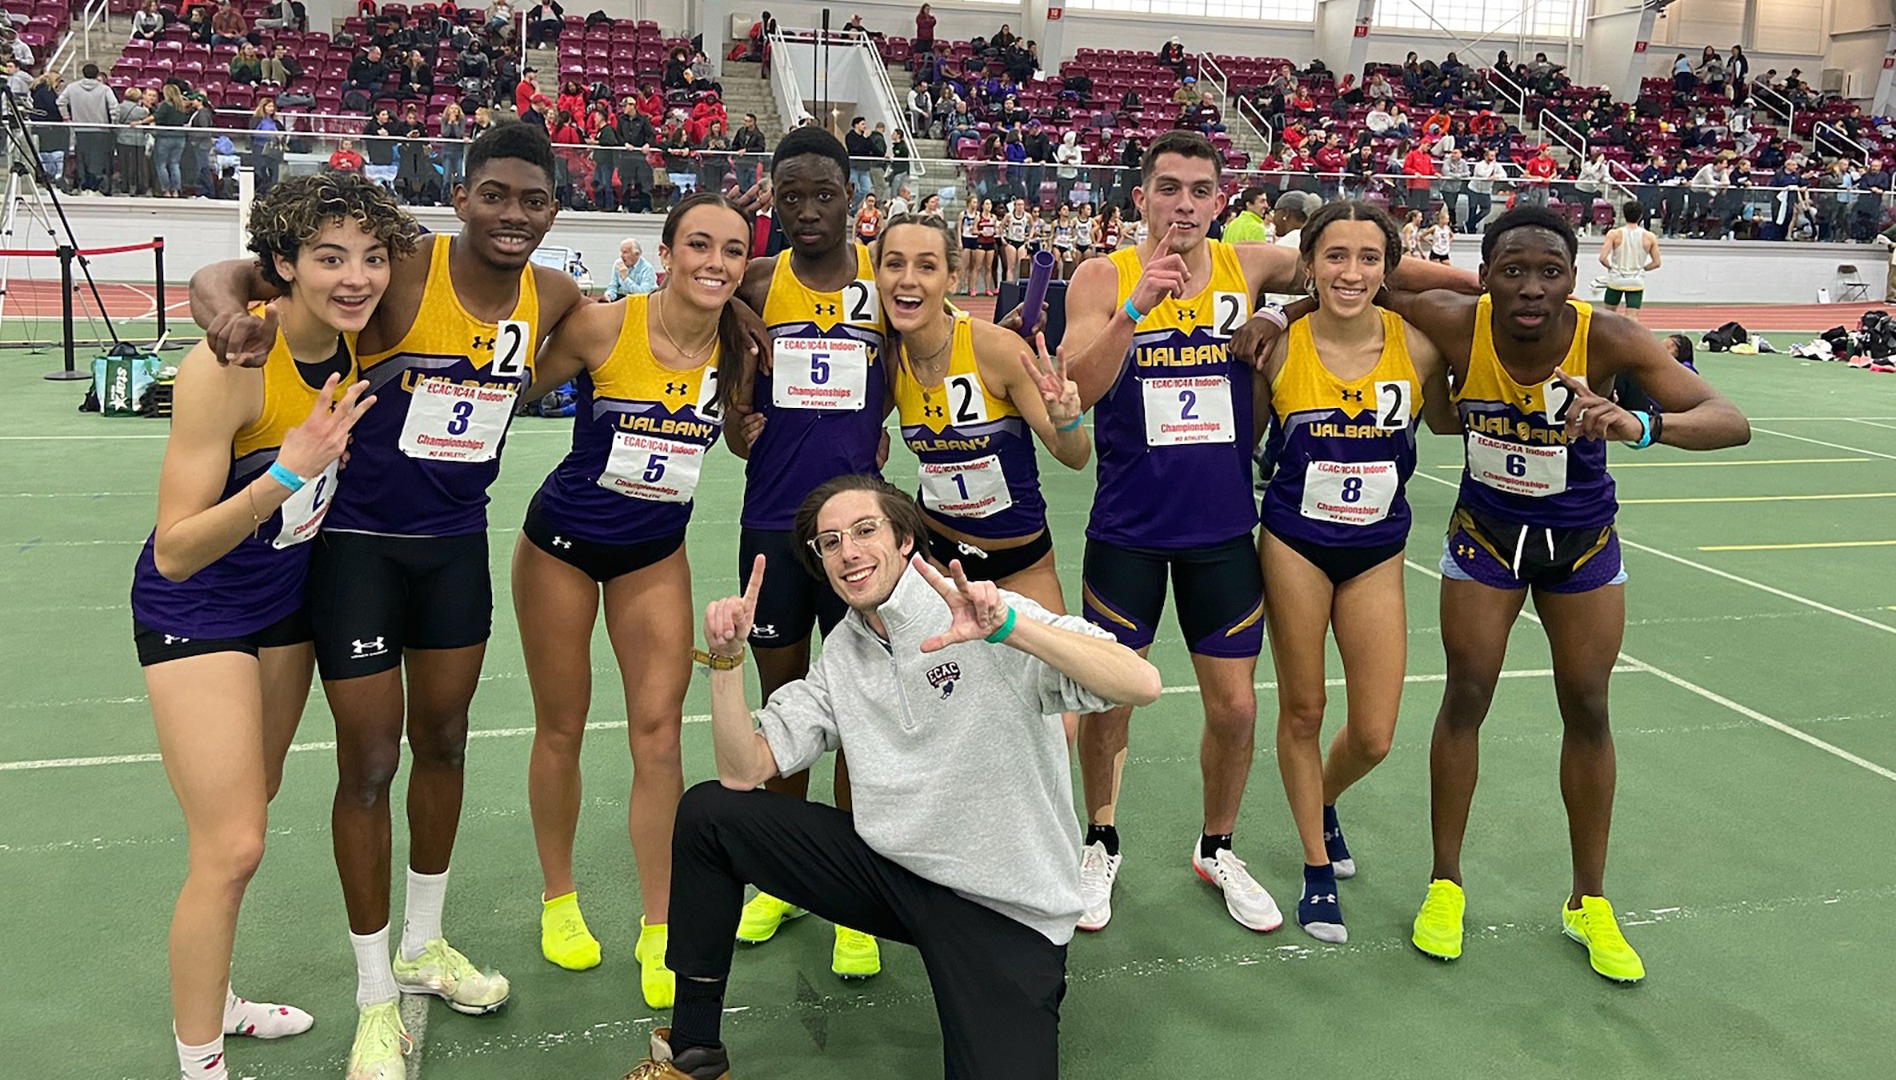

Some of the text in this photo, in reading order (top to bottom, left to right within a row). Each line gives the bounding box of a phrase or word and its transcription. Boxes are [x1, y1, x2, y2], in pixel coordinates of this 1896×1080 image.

[848, 281, 872, 321] 2
[1219, 294, 1240, 335] 2
[498, 323, 521, 373] 2
[784, 340, 857, 351] ECAC/IC4A Indoor
[1136, 343, 1229, 367] UALBAN
[810, 353, 830, 385] 5
[426, 383, 507, 402] ECAC/IC4A Indoor
[702, 371, 719, 418] 2
[787, 386, 851, 398] Championships
[1152, 377, 1222, 389] ECAC/IC4A Indoor
[951, 377, 979, 423] 2
[1178, 390, 1199, 420] 2
[1382, 383, 1403, 427] 2
[1551, 381, 1576, 422] 2
[447, 401, 474, 435] 3
[619, 413, 713, 439] UALBANY
[1160, 422, 1221, 433] Championships
[1468, 412, 1570, 445] UALBAN
[416, 434, 485, 450] Championships
[669, 444, 698, 455] Indoor
[907, 435, 991, 452] ALBANY
[1525, 446, 1557, 458] Indoor
[642, 454, 669, 483] 5
[1363, 464, 1388, 475] Indoor
[1505, 453, 1526, 477] 6
[614, 478, 680, 496] Championships
[951, 473, 969, 500] 1
[1341, 477, 1363, 503] 8
[1482, 470, 1550, 490] Championships
[312, 475, 327, 512] 2
[938, 496, 997, 511] Championships
[1317, 502, 1380, 515] Championships
[927, 662, 959, 682] ECAC
